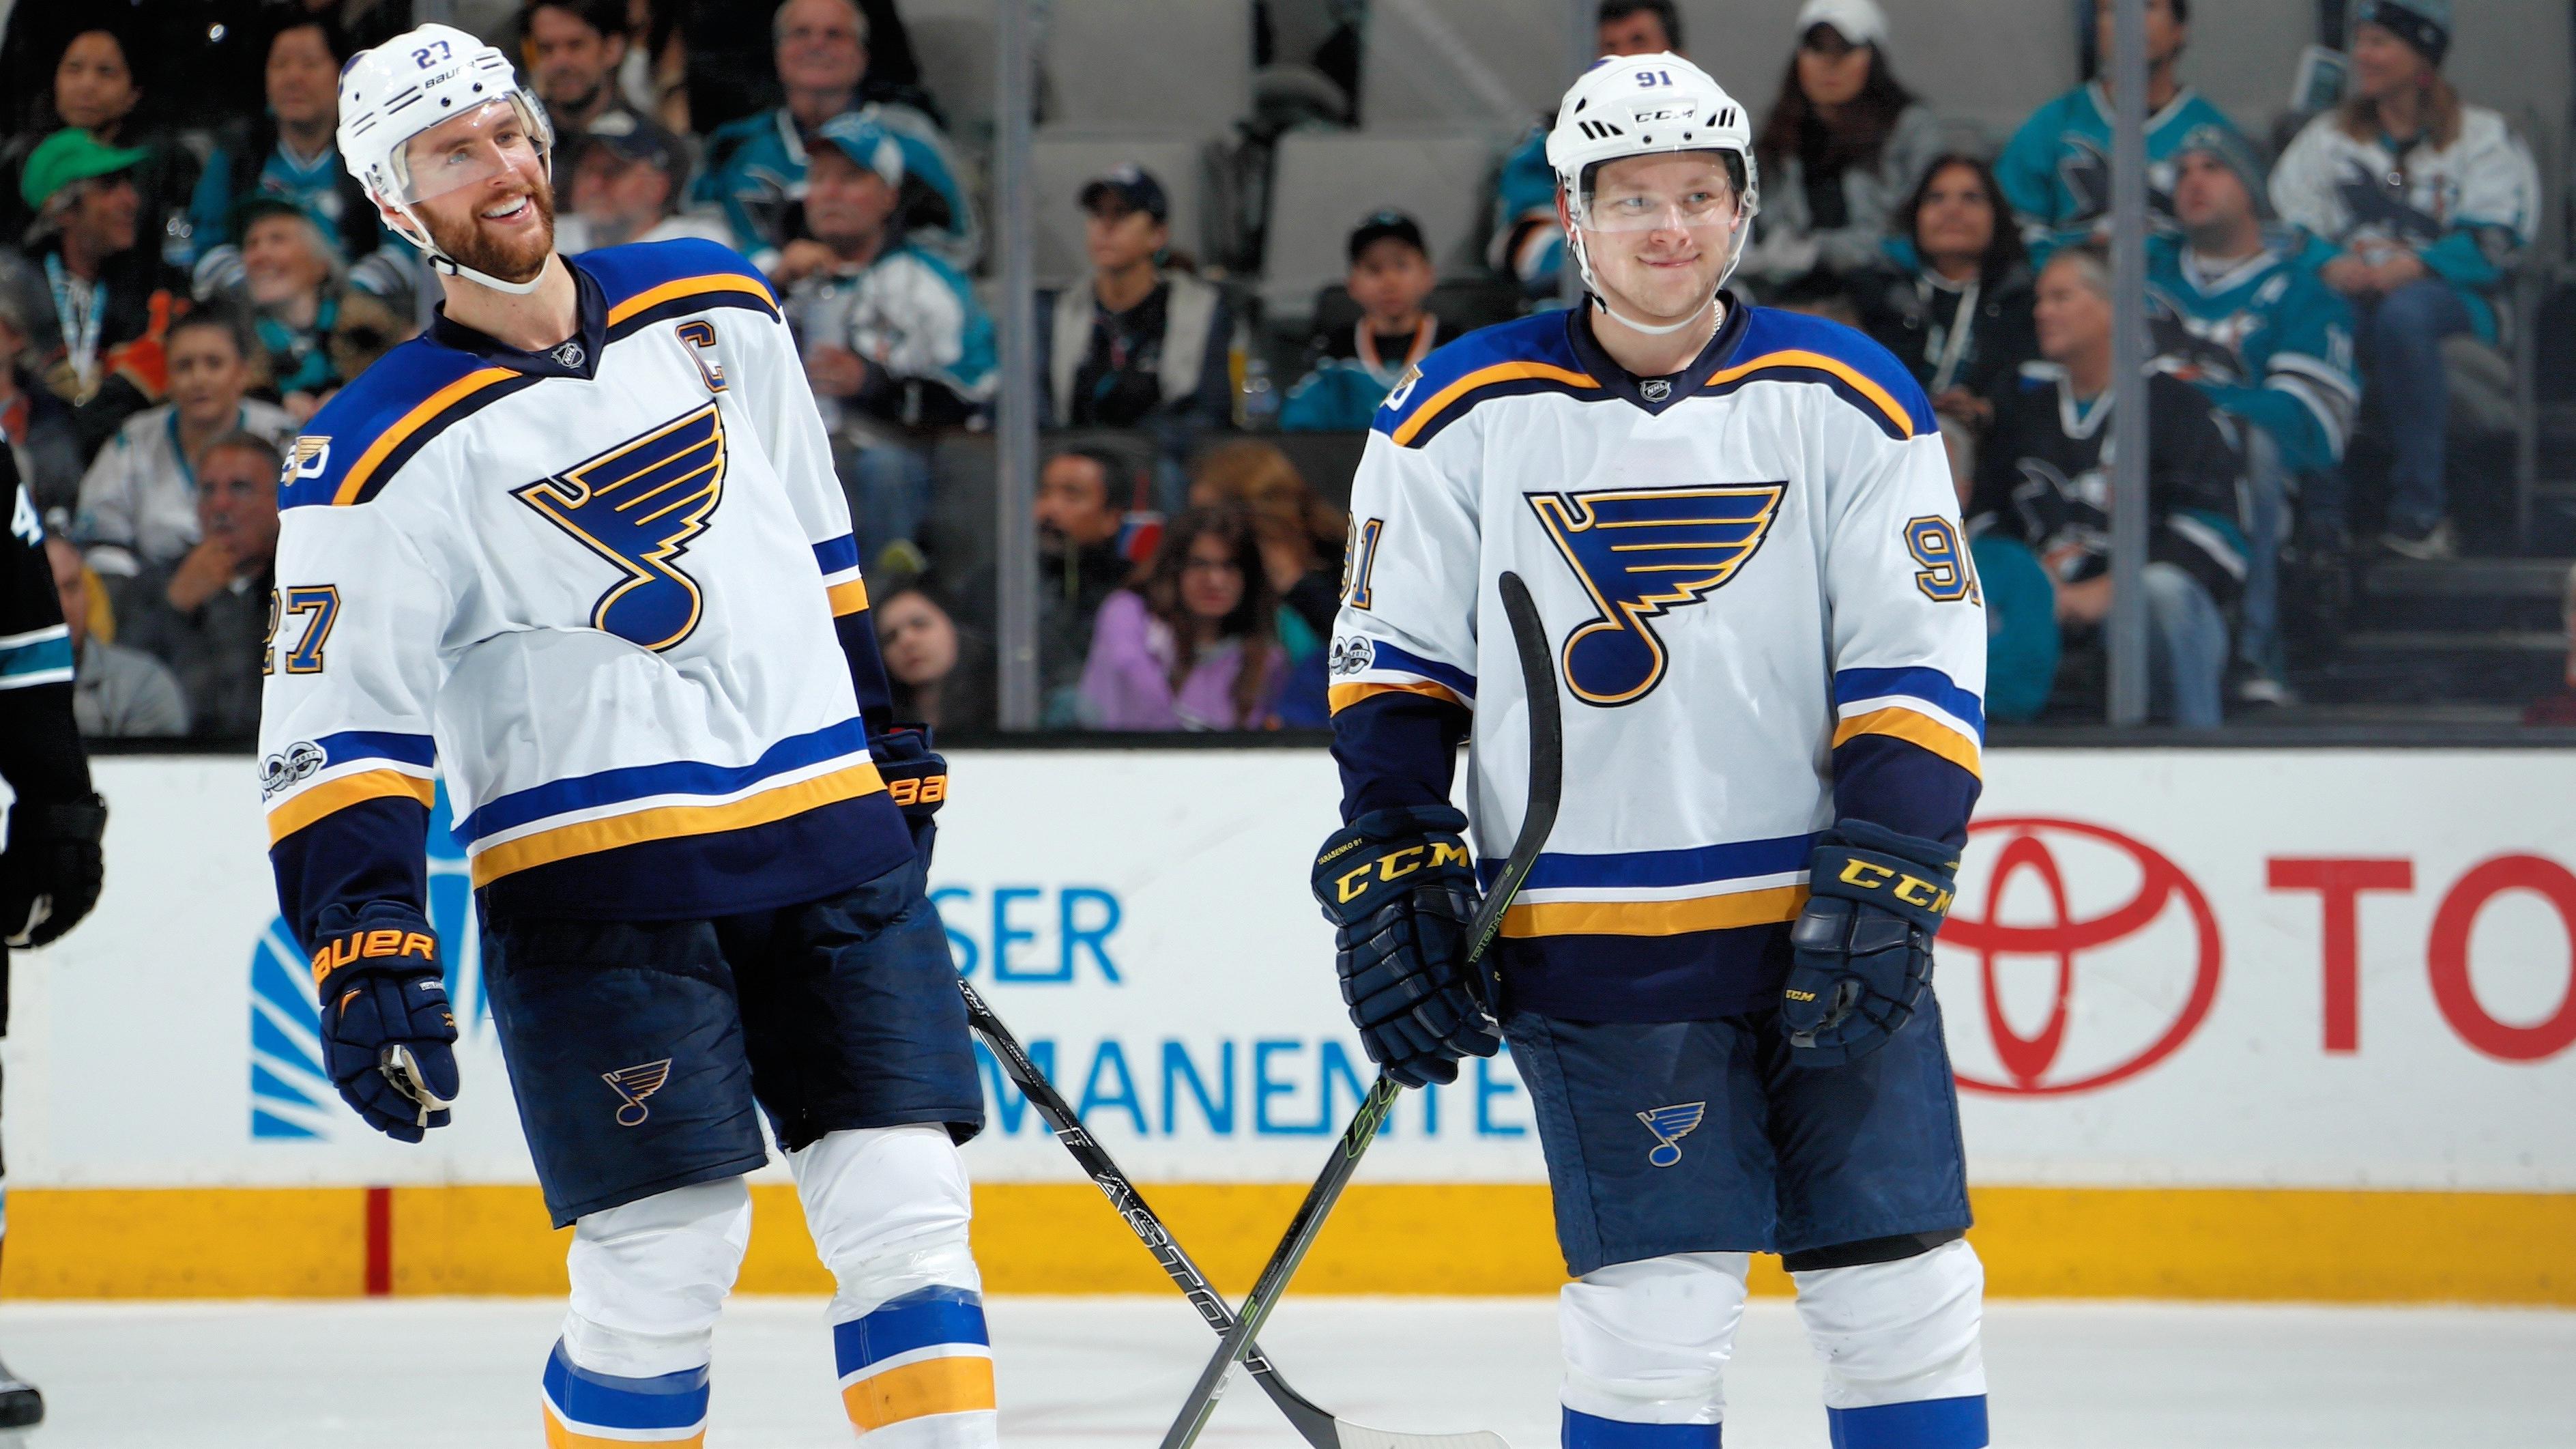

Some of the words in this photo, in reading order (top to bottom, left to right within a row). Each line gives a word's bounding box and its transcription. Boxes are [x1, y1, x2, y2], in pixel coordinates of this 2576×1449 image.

[411, 40, 452, 70] 27
[1635, 70, 1673, 87] 91
[675, 320, 730, 394] C
[1647, 382, 1665, 396] NHL
[1317, 842, 1355, 865] TARASENKO
[1334, 842, 1468, 904] CCM
[1838, 858, 1954, 917] CCM
[311, 929, 435, 988] AUER
